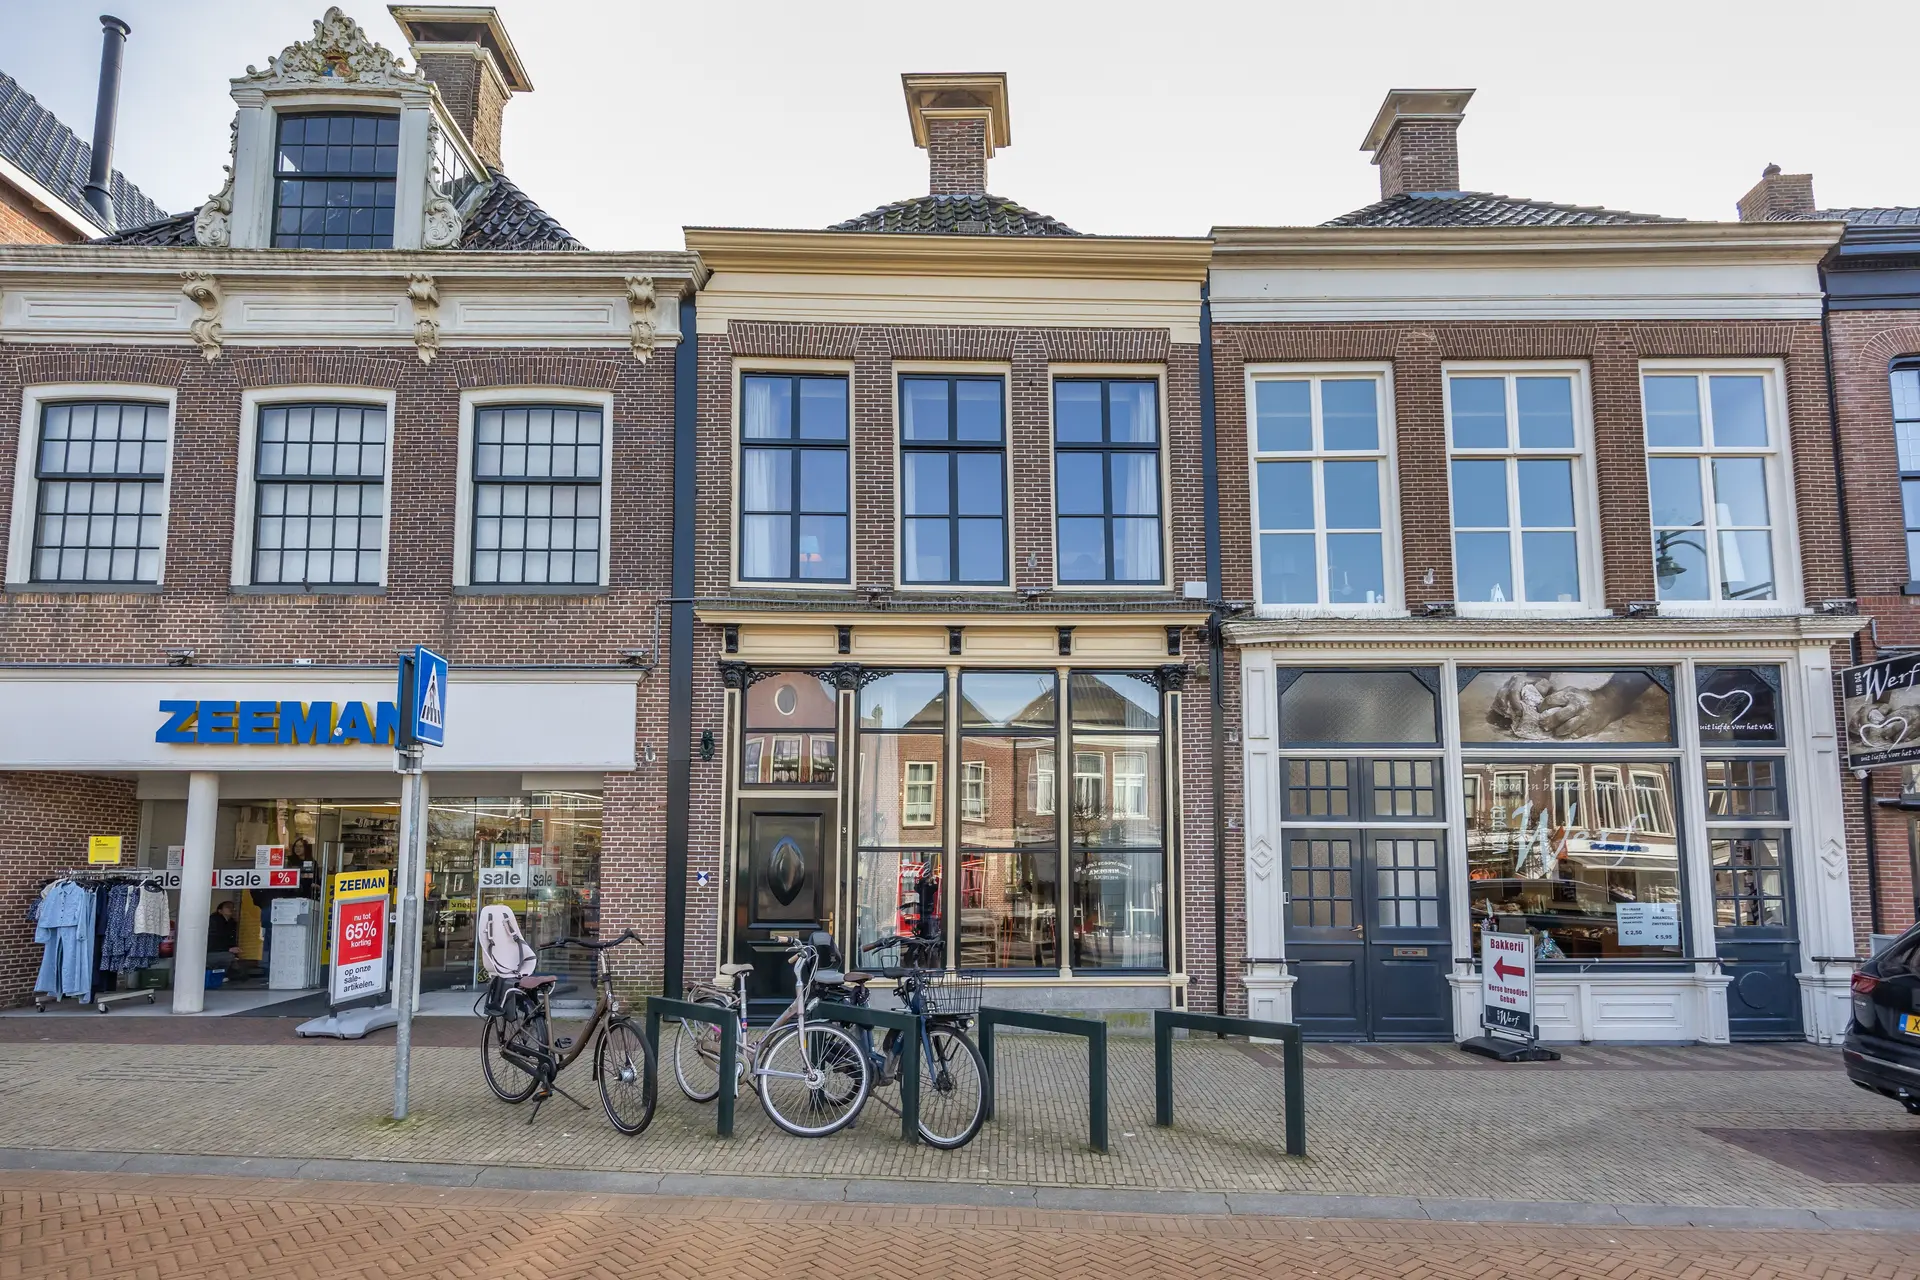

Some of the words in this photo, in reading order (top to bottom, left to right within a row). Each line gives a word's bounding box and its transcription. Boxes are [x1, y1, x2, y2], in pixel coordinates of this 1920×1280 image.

[1863, 663, 1920, 701] Werf
[1712, 723, 1731, 733] liefde
[1759, 722, 1774, 730] vak
[1861, 753, 1870, 761] uit
[1872, 750, 1887, 762] liefde
[1901, 748, 1911, 757] het
[841, 826, 847, 834] 3
[1512, 799, 1649, 877] Werf
[155, 872, 181, 887] ale
[224, 871, 261, 887] sale
[278, 872, 290, 883] %
[340, 877, 386, 892] ZEEMAN
[482, 870, 521, 885] sale
[533, 871, 552, 887] sale
[362, 912, 371, 920] tot
[345, 921, 377, 941] 65%
[350, 939, 371, 948] korting
[1490, 938, 1524, 953] Bakkerij
[344, 968, 353, 976] op
[355, 964, 371, 974] onze
[343, 976, 361, 985] sale-
[343, 980, 375, 993] artikelen.
[1488, 984, 1503, 993] Verse
[1504, 986, 1528, 997] broodjes
[1499, 995, 1516, 1004] Gebak
[1500, 1010, 1520, 1027] Werf
